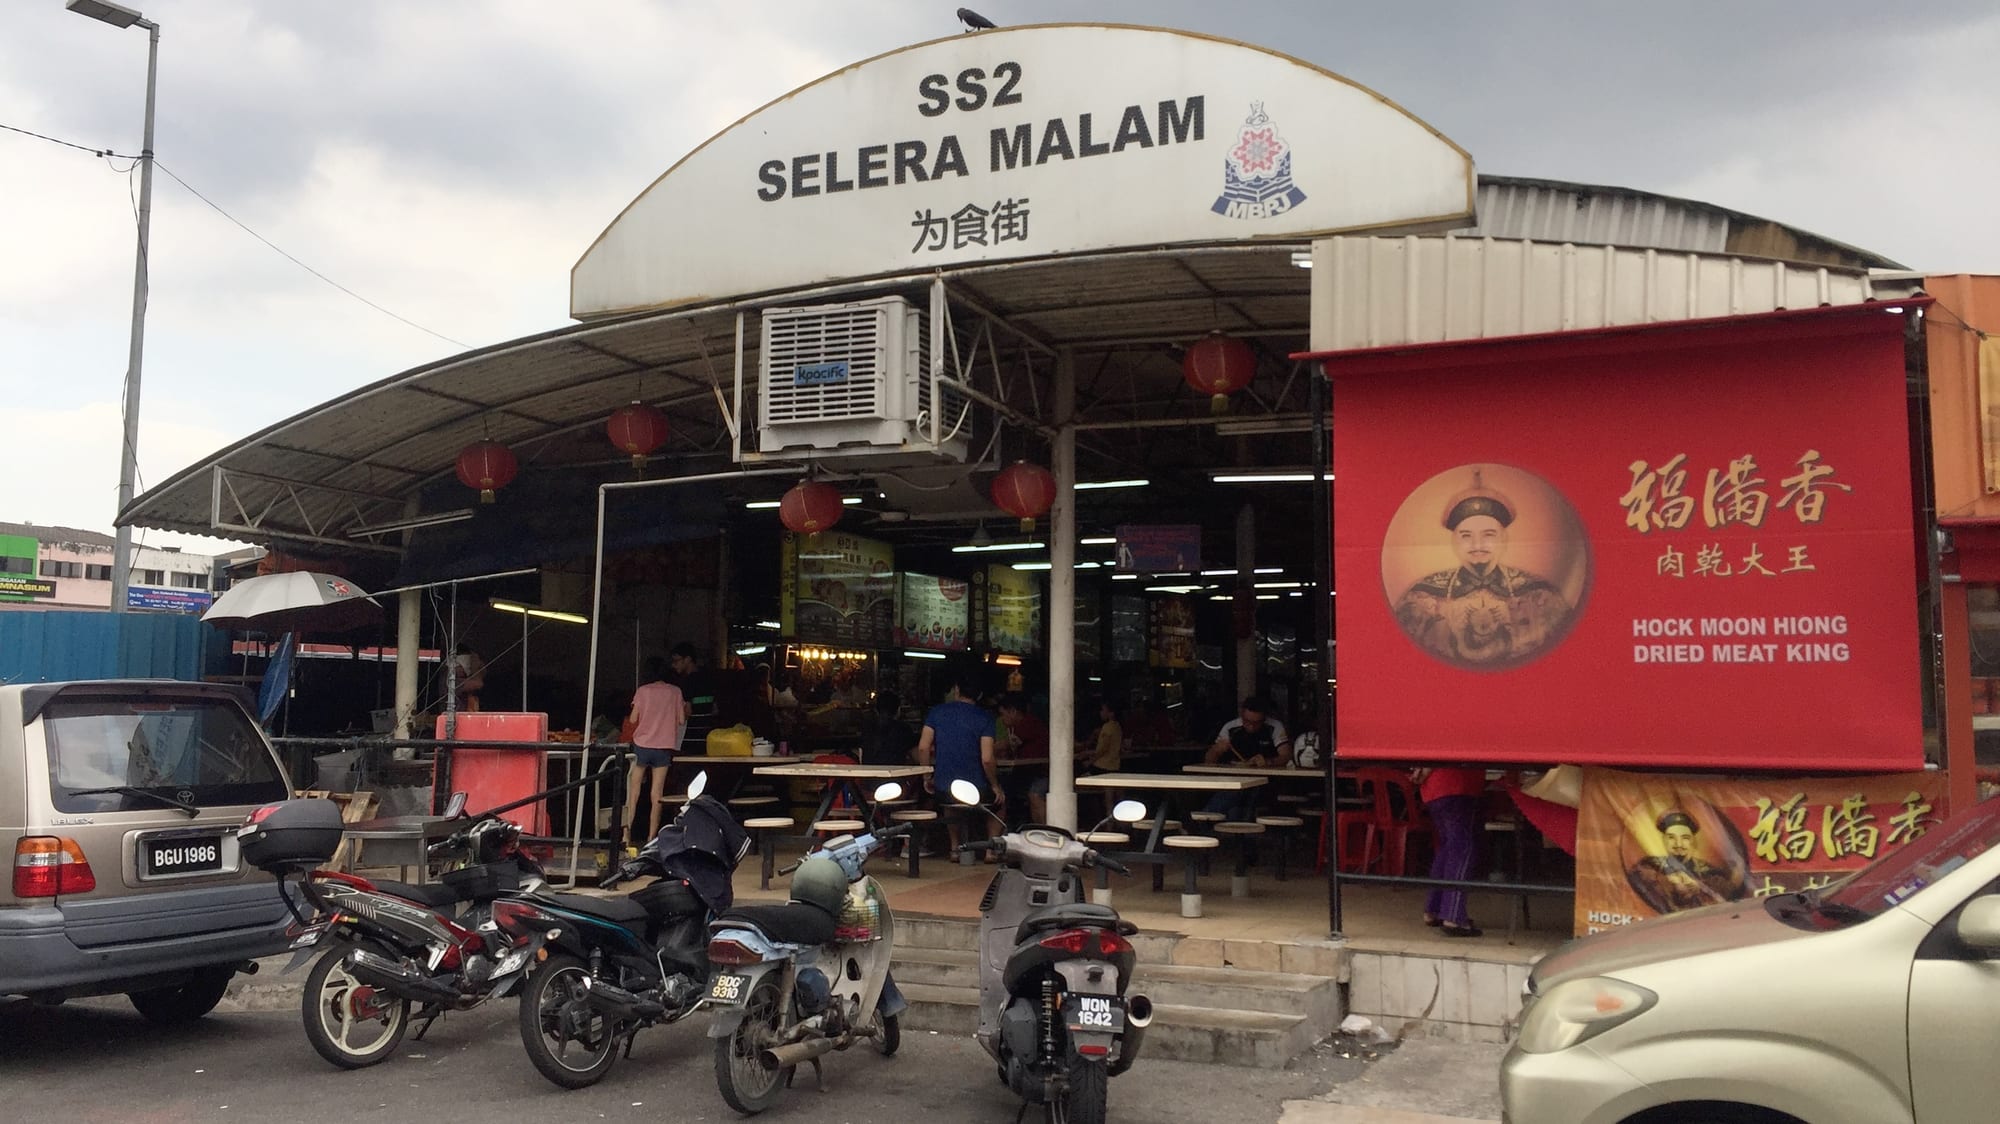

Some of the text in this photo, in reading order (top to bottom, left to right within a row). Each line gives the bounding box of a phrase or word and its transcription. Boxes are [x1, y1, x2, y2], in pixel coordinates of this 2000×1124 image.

[918, 61, 1023, 117] SS2
[757, 95, 1205, 202] SELERA MALAM
[1223, 194, 1292, 220] MBPJ
[911, 197, 1030, 254] 为食街
[1656, 542, 1816, 578] 肉乾大王
[1633, 616, 1848, 637] HOCK MOON HIONG
[1634, 643, 1850, 663] DRIED MEAT KING
[1588, 910, 1633, 925] HOCK
[717, 975, 741, 987] BDG
[711, 986, 739, 999] 9310
[1080, 997, 1110, 1012] WQN
[1078, 1011, 1112, 1026] 1642
